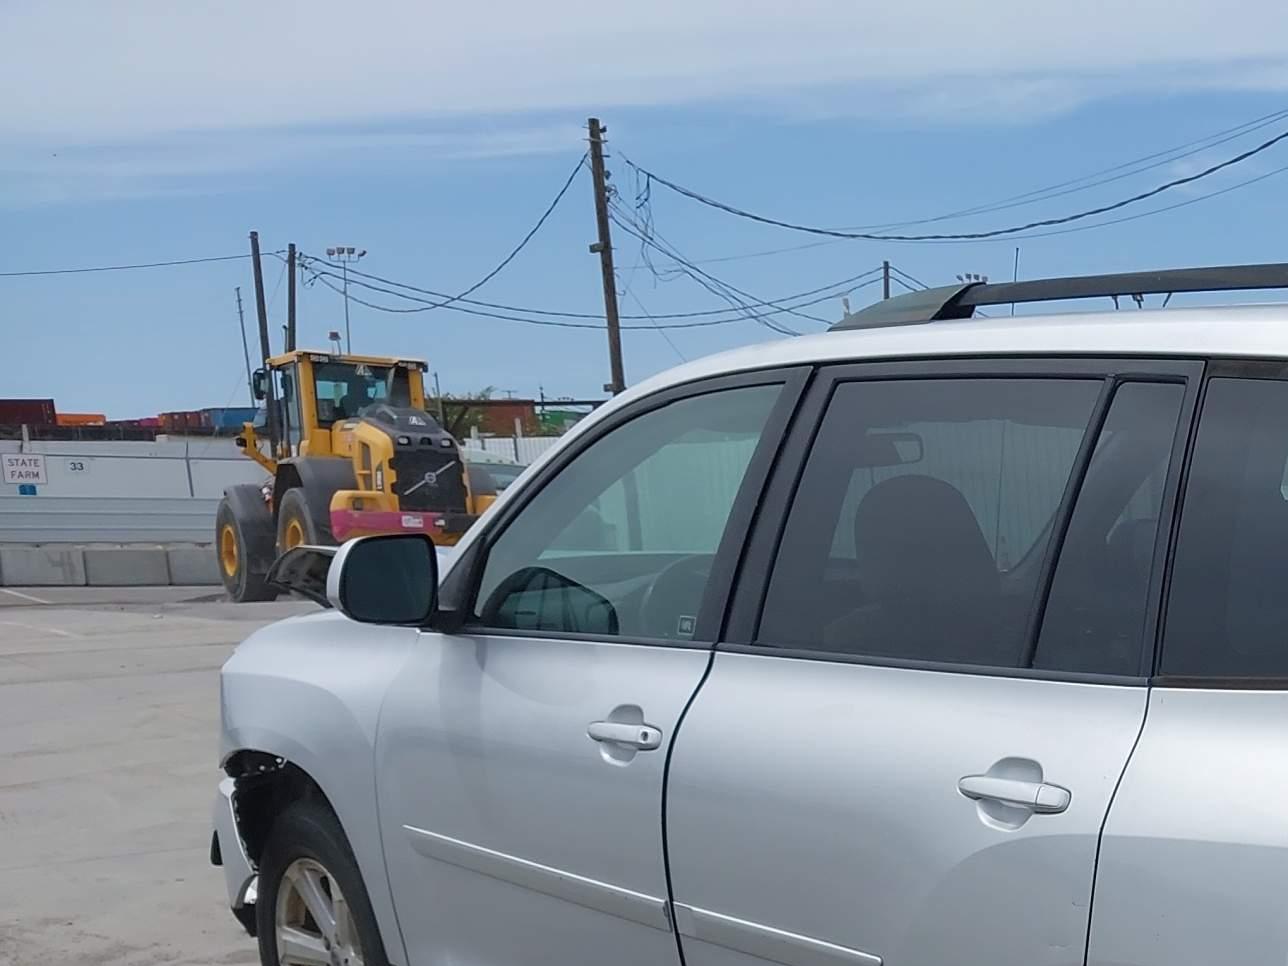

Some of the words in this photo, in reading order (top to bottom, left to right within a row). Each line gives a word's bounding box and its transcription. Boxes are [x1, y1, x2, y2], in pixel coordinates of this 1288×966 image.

[7, 458, 40, 467] STATE
[69, 462, 84, 471] 33
[10, 470, 40, 480] FARM
